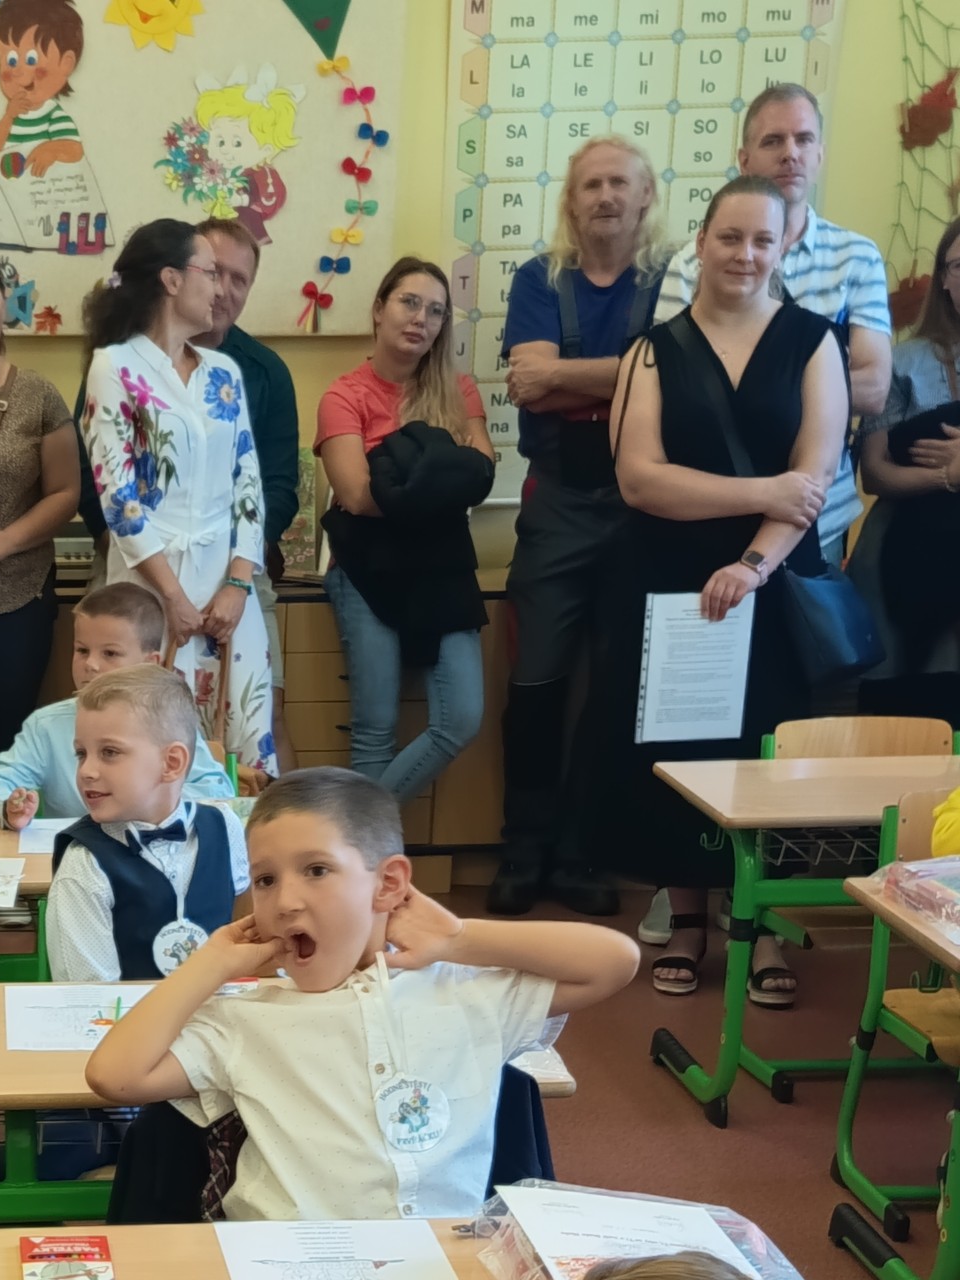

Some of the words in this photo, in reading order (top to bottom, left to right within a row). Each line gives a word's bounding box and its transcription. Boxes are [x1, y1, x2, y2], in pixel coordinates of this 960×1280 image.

[471, 0, 485, 14] M
[510, 15, 535, 27] ma
[574, 14, 598, 26] me
[639, 10, 659, 25] mi
[701, 11, 727, 23] mo
[766, 9, 792, 21] mu
[510, 54, 530, 69] LA
[573, 53, 594, 67] LE
[639, 51, 653, 66] LI
[699, 49, 722, 65] LO
[764, 47, 787, 63] LU
[469, 70, 479, 85] L
[511, 84, 525, 98] la
[574, 83, 588, 96] le
[640, 80, 648, 94] li
[701, 78, 716, 93] lo
[506, 124, 528, 139] SA
[568, 123, 590, 138] SE
[633, 121, 649, 136] SI
[693, 119, 718, 134] SO
[465, 139, 476, 154] S
[506, 154, 525, 168] sa
[693, 151, 713, 163] so
[503, 193, 523, 208] PA
[689, 188, 713, 203] PO
[463, 208, 473, 222] P
[501, 222, 522, 237] pa
[459, 275, 470, 290] T
[456, 342, 465, 356] J
[491, 393, 513, 406] NA
[491, 420, 509, 433] na
